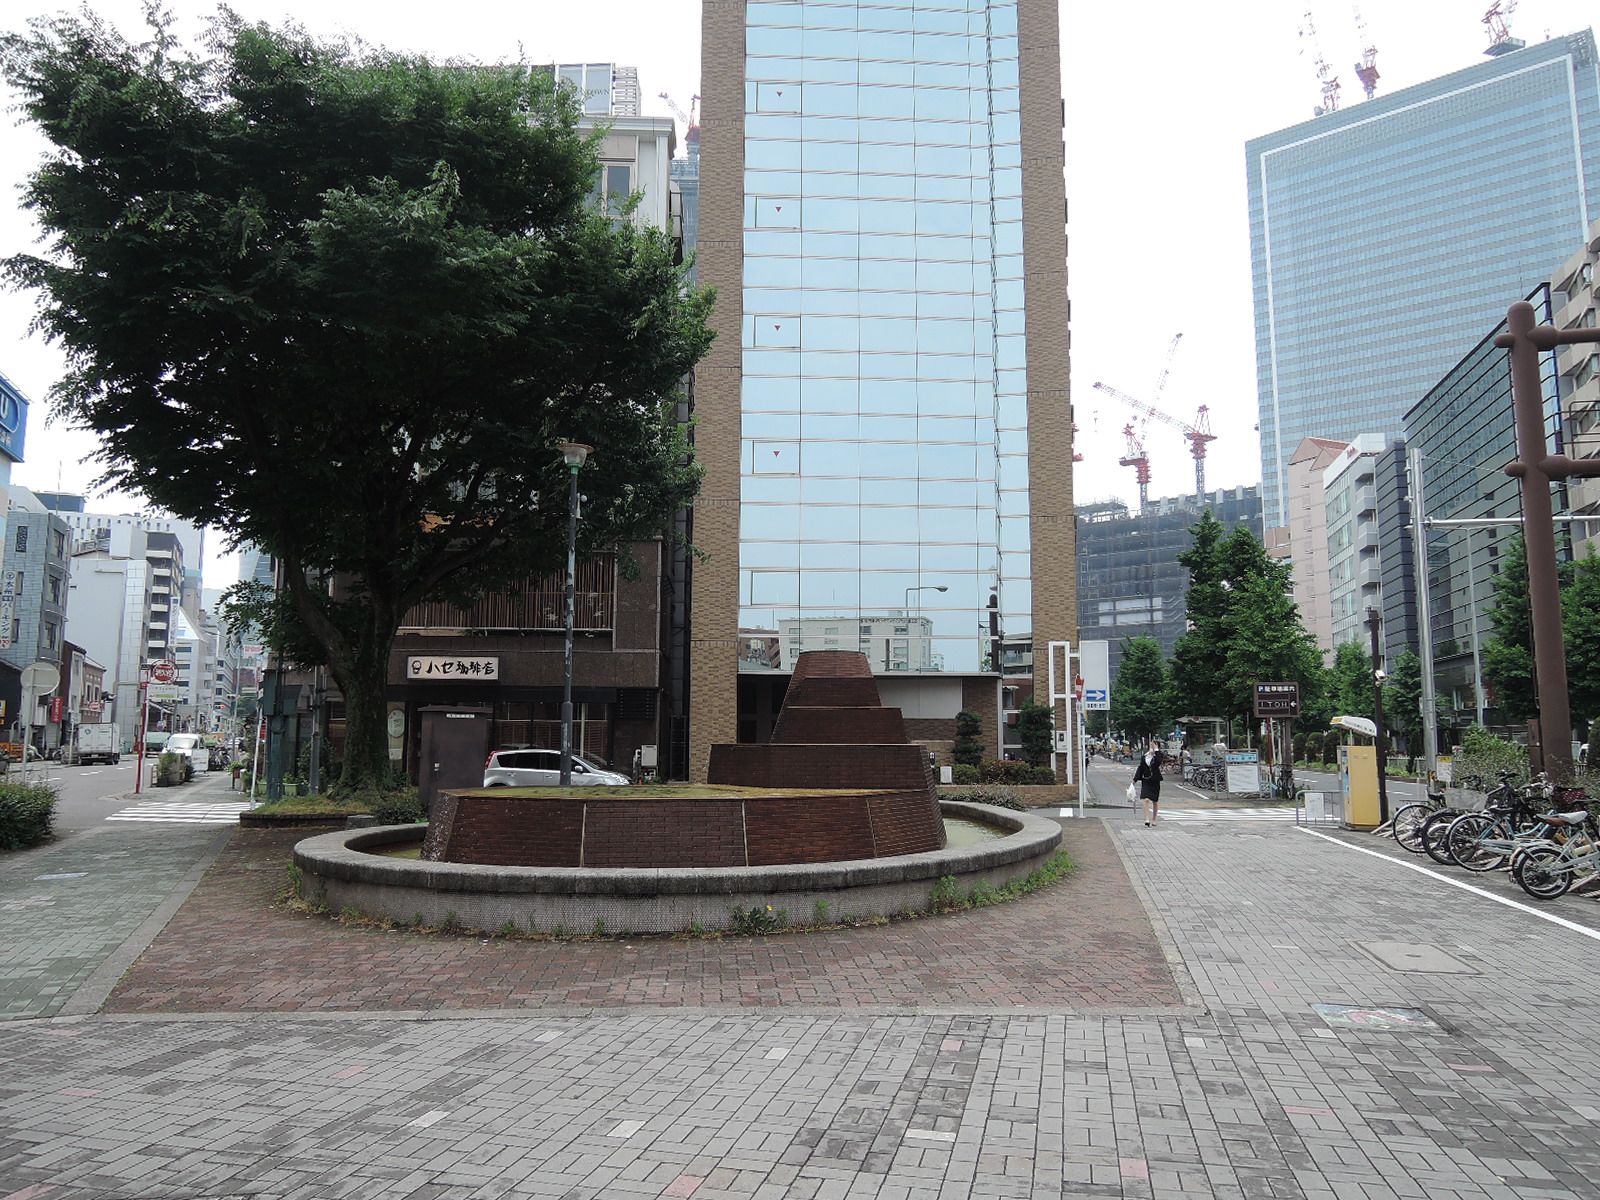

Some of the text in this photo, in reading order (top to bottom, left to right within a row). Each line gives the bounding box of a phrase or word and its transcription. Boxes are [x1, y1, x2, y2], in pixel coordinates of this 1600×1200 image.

[425, 660, 495, 676] ハセ珈琲店
